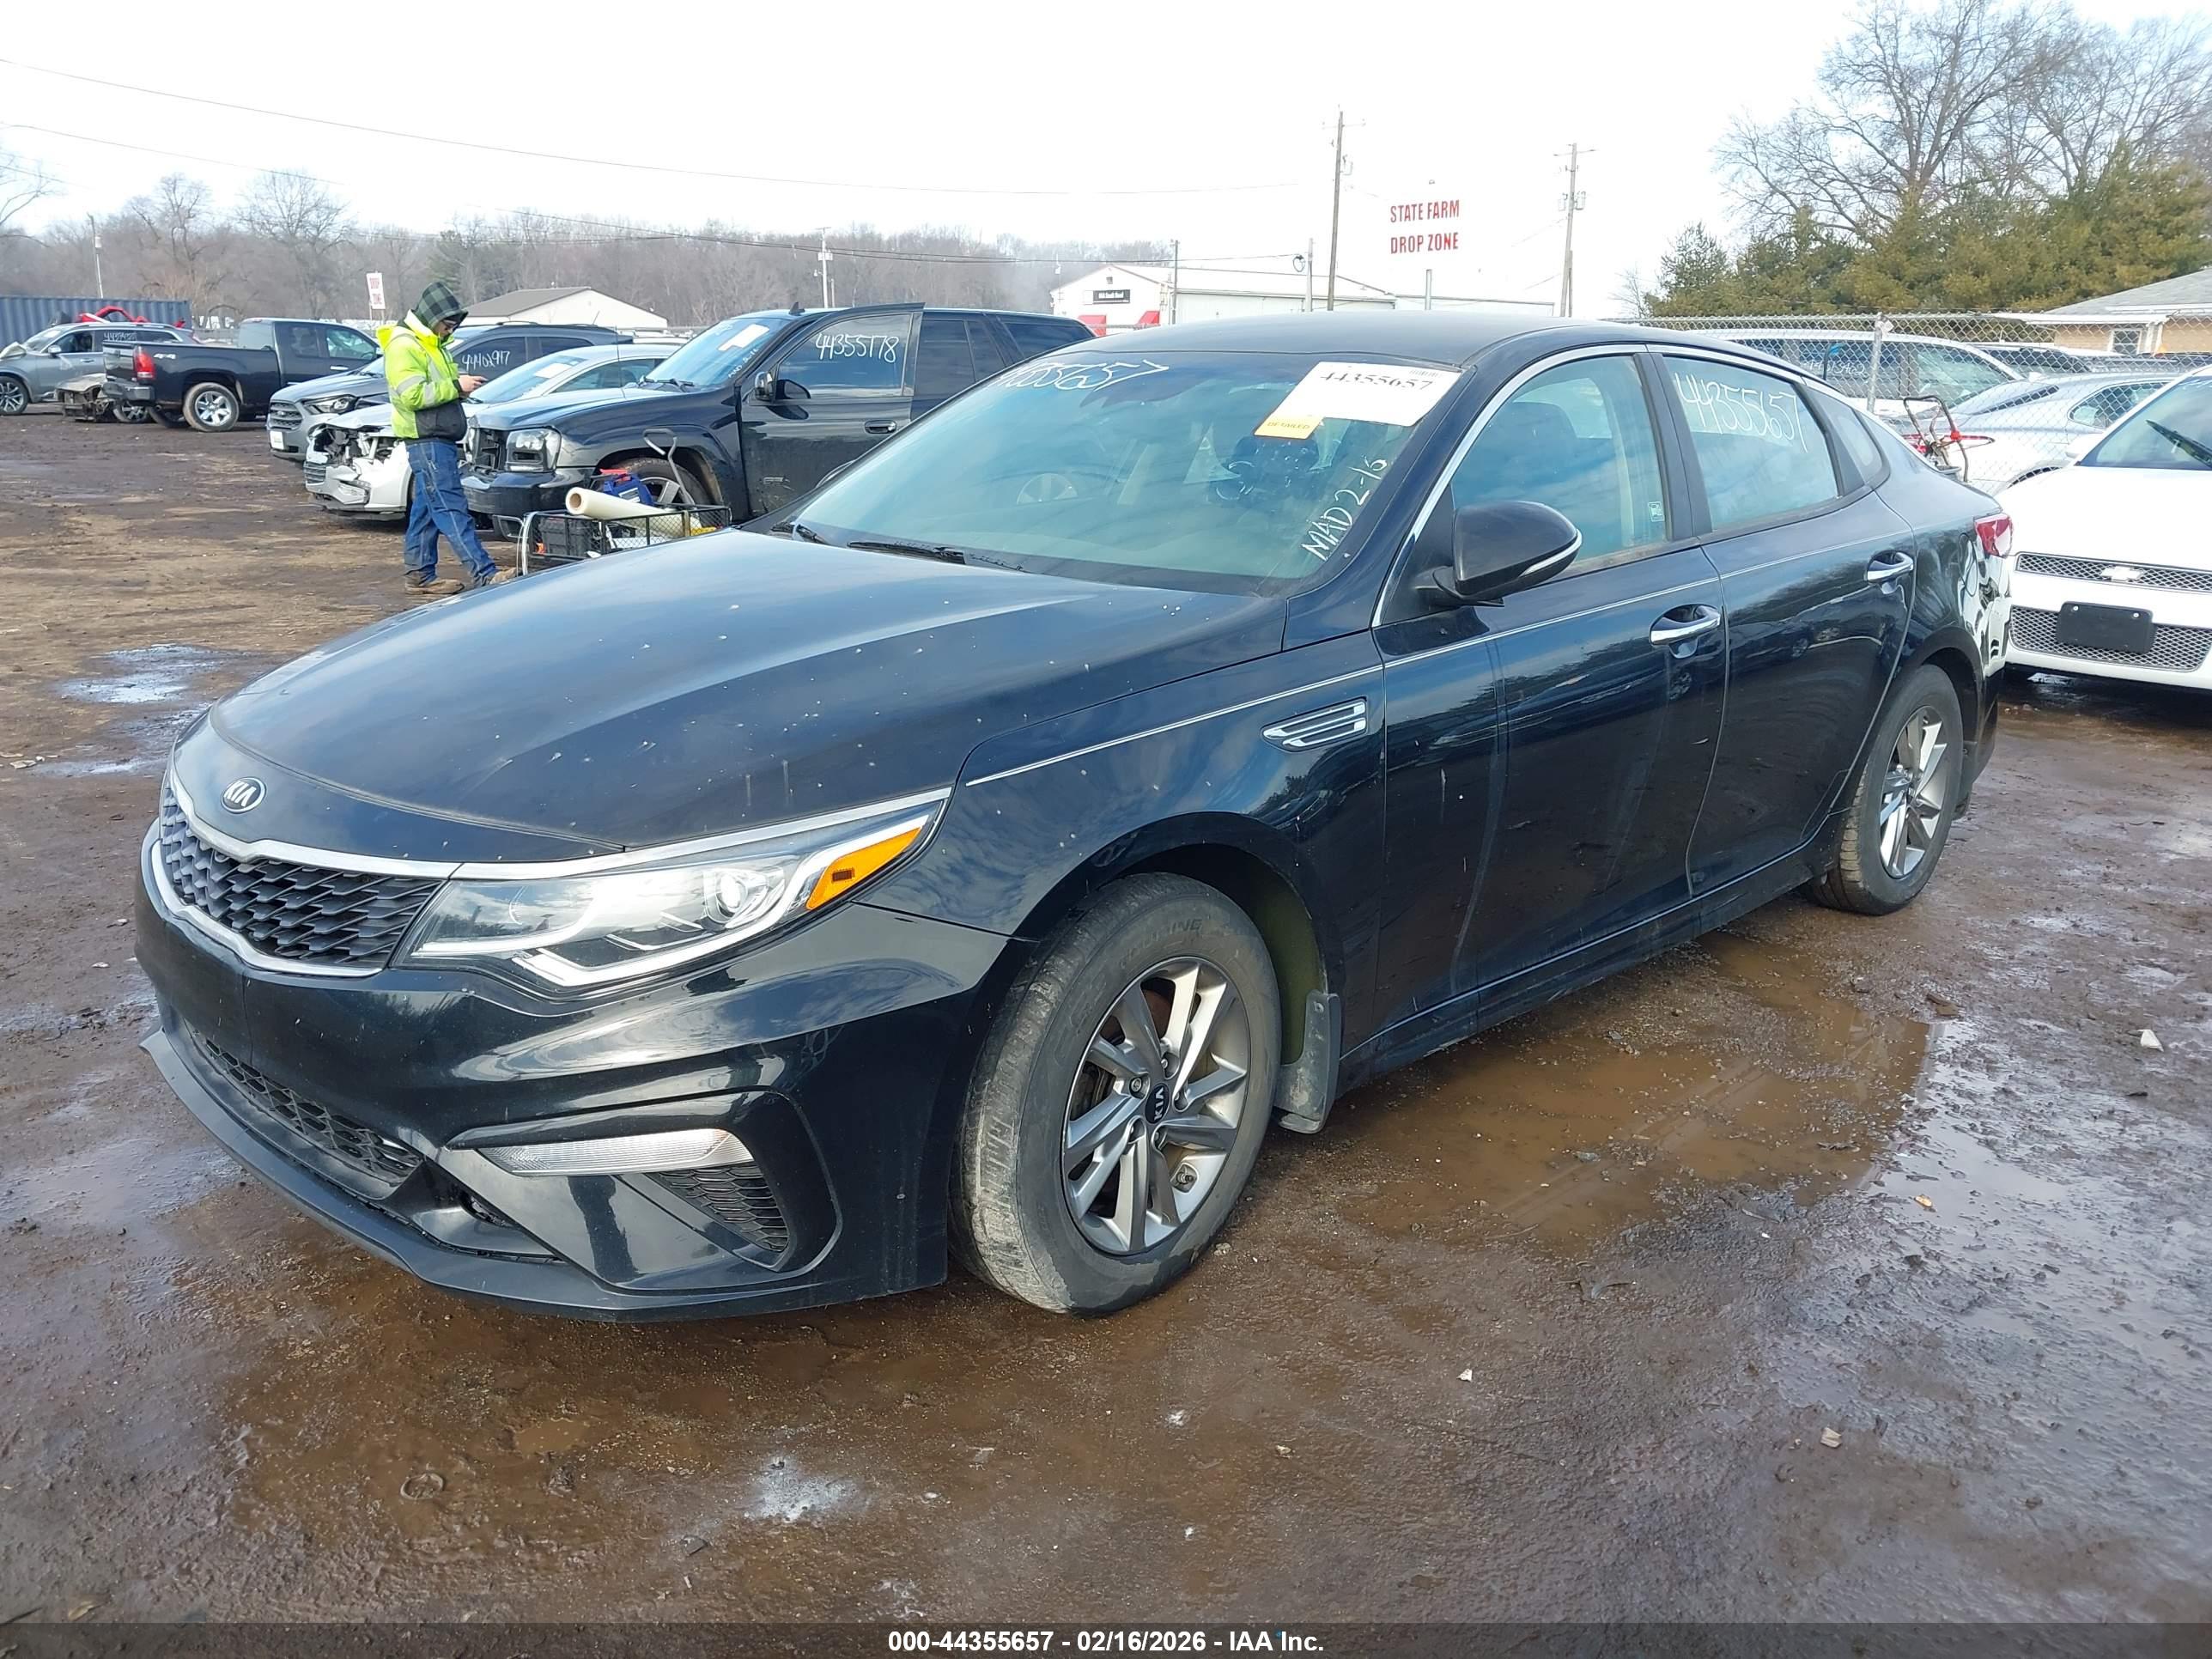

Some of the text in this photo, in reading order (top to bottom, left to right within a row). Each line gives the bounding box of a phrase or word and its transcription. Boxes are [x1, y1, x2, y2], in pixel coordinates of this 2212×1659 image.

[1390, 199, 1460, 223] STATE FARM
[1390, 232, 1459, 254] DROP ZONE
[816, 333, 899, 363] 44355178
[1301, 507, 1353, 562] MAD
[223, 781, 257, 807] KIA
[1153, 1087, 1164, 1121] KIA
